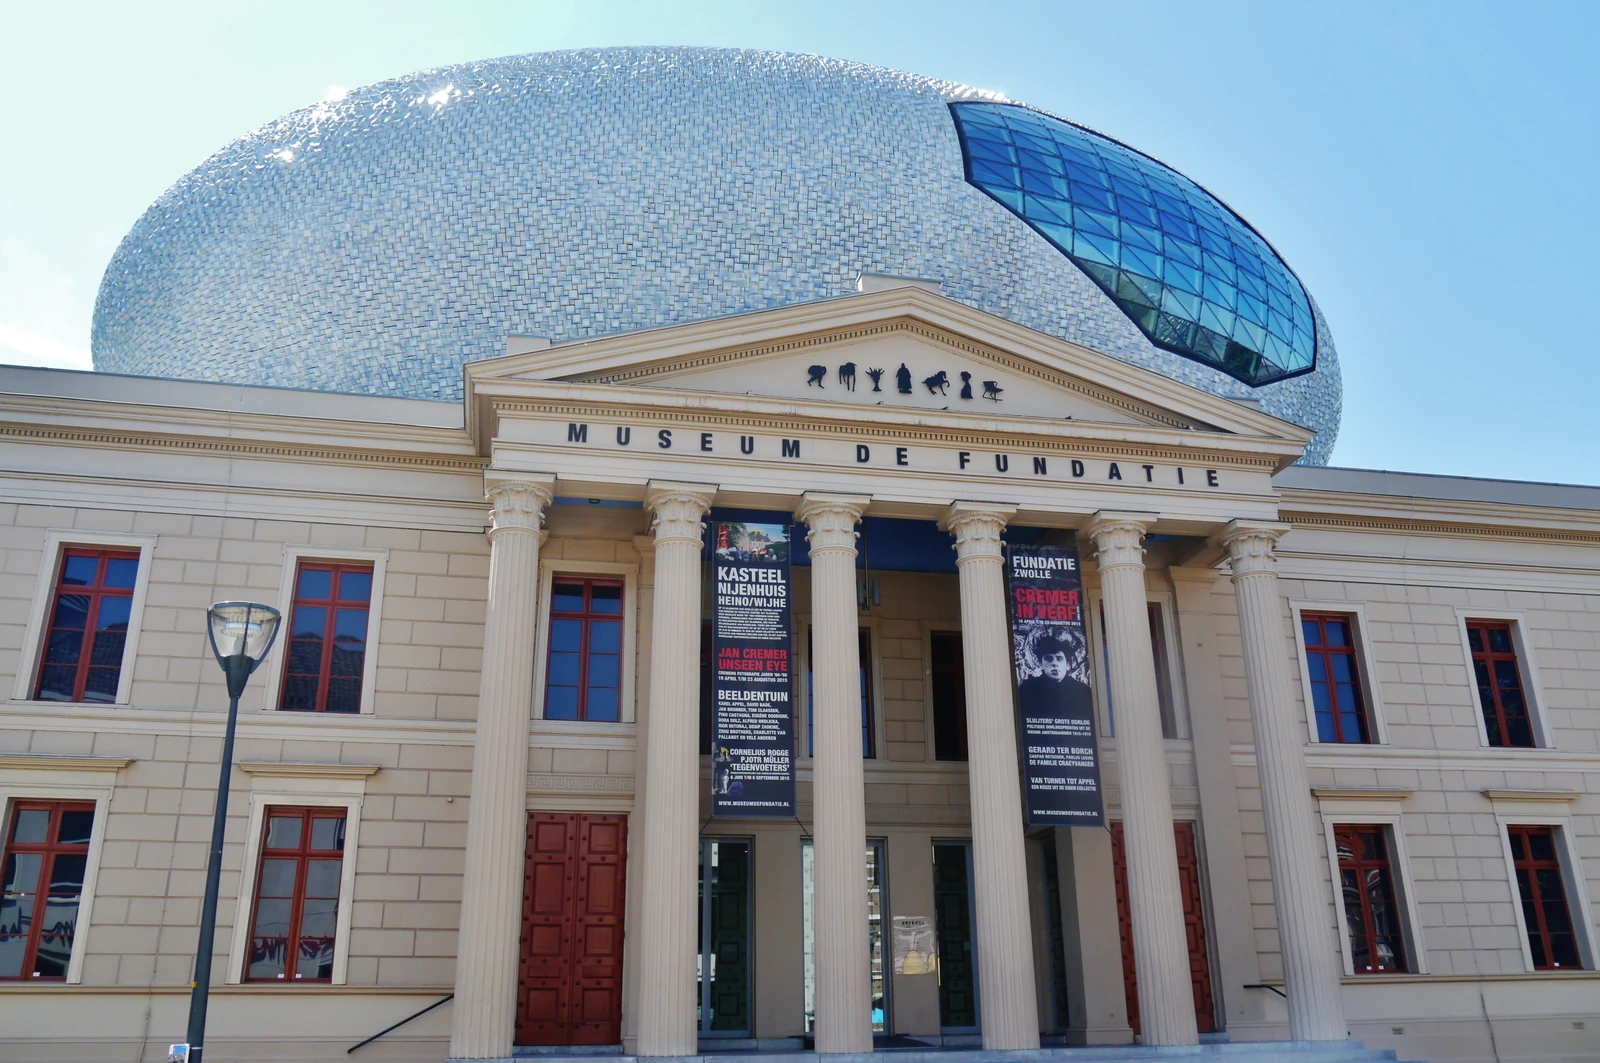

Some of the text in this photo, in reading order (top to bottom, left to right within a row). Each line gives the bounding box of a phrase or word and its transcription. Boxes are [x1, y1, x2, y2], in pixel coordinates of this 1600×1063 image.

[568, 423, 1219, 487] MUSEUM DE FUNDATIE
[1013, 556, 1075, 570] FUNDATIE
[718, 566, 786, 584] KASTEEL
[1014, 569, 1051, 579] ZWOLLE
[718, 582, 786, 597] NIJENHUIS
[718, 596, 786, 608] HEINO/WIJHE
[1016, 589, 1079, 605] CREMER
[1017, 604, 1034, 618] IN
[1037, 605, 1076, 621] VERF
[719, 648, 787, 661] JAN CREMER
[719, 659, 787, 671] UNSEEN EYE
[718, 690, 788, 701] BEELDENTUIN
